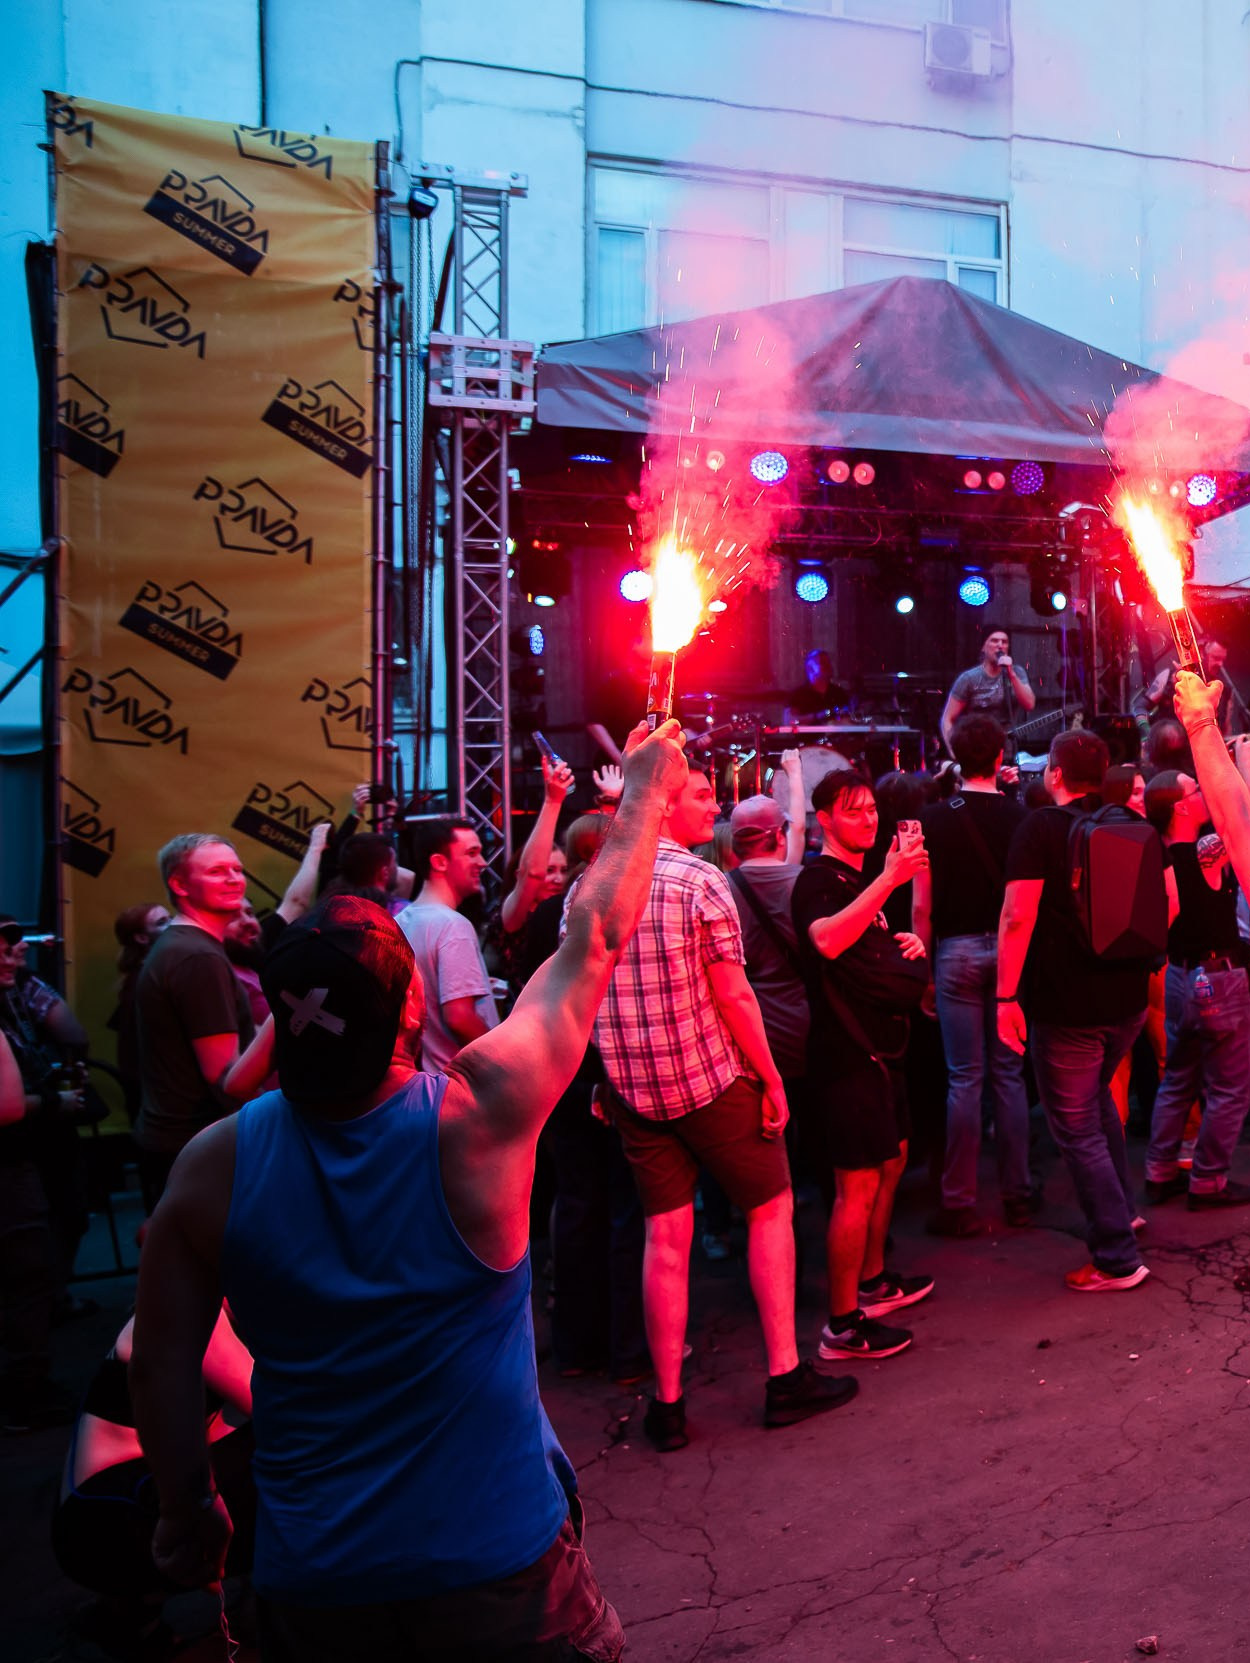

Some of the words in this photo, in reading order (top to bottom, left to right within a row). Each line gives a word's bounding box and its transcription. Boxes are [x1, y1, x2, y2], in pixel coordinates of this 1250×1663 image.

[159, 169, 270, 254] PRAVDA
[173, 211, 236, 257] SUMMER
[78, 262, 207, 359] PRAVDA
[57, 399, 125, 454] AVDA
[288, 418, 349, 462] SUMMER
[193, 475, 314, 565] PRAVDA
[136, 580, 243, 657] PRAVDA
[147, 622, 212, 664] SUMMER
[62, 668, 189, 755] PRAVDA
